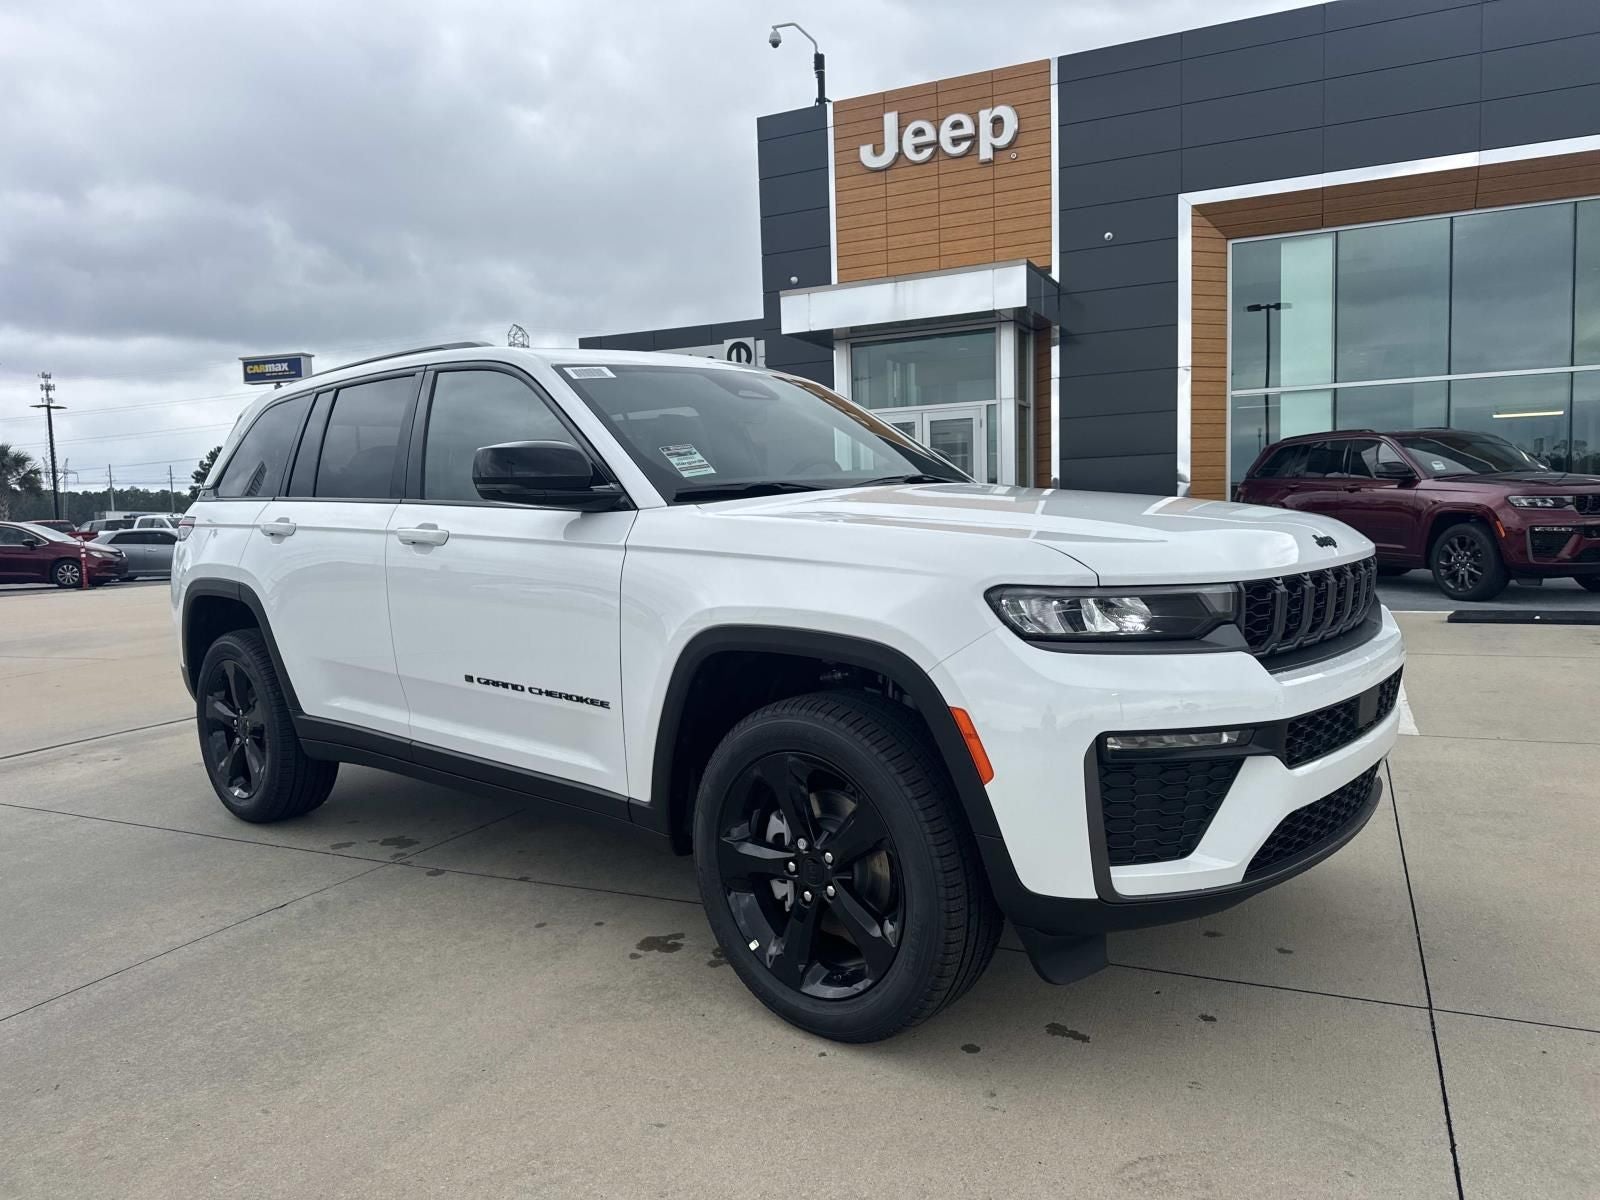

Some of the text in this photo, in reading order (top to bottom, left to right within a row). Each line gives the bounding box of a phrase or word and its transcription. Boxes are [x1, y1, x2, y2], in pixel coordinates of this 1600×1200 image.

[859, 104, 1019, 171] Jeep
[476, 677, 611, 709] GRAND CHEROKEE
